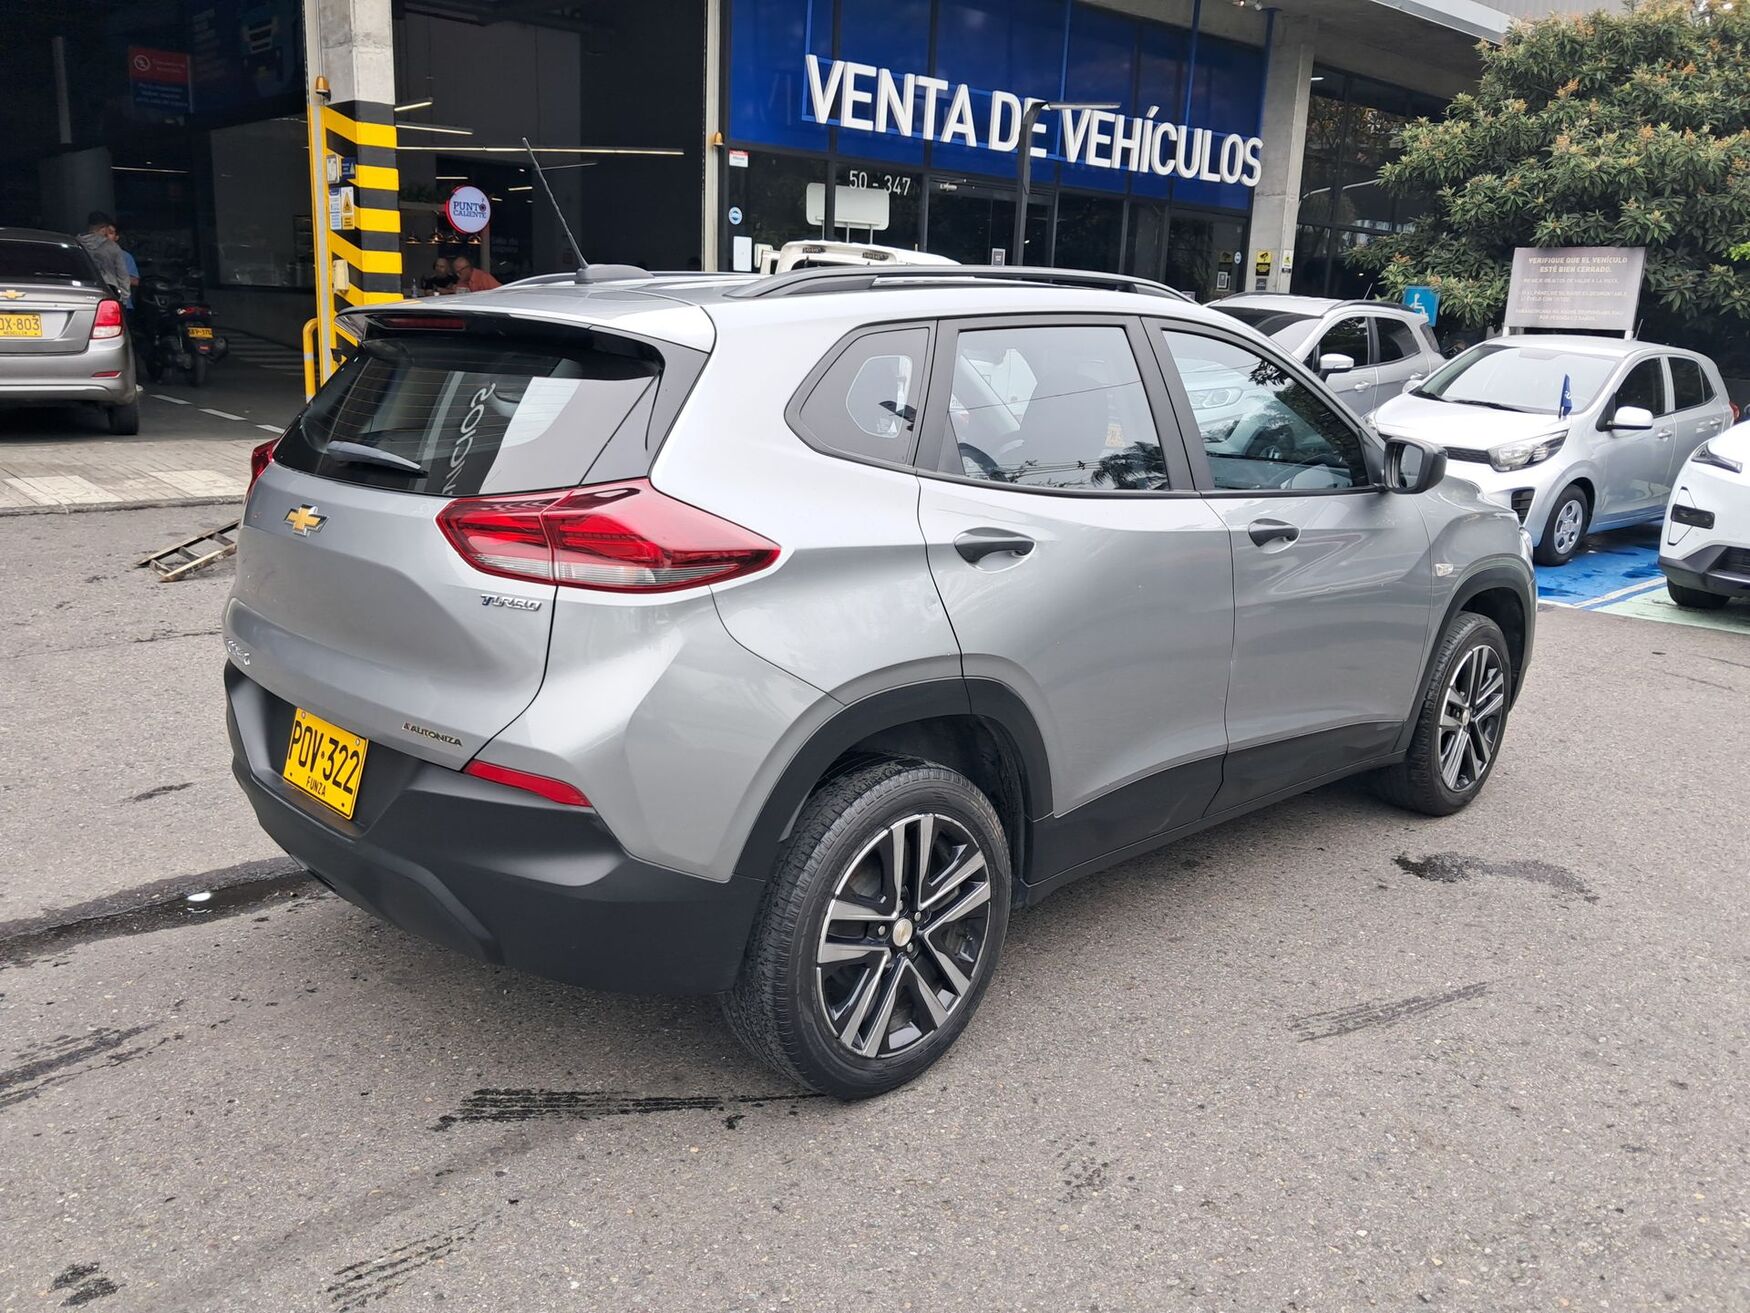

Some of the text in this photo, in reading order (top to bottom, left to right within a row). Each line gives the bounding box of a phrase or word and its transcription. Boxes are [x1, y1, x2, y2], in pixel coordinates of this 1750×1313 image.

[805, 54, 1264, 188] VENTA DE VEHÍCULOS
[849, 170, 867, 190] 50
[884, 175, 911, 196] 347
[453, 201, 486, 212] PUNTO
[453, 209, 486, 219] CALIENTE
[1528, 254, 1628, 264] VERIFIQUE QUE EL VEHÍCULO
[1539, 265, 1558, 273] ESTÉ
[1558, 265, 1576, 273] BIEN
[480, 594, 542, 611] TURBO
[410, 725, 463, 746] AUTONIZA
[306, 776, 327, 797] FUNZA
